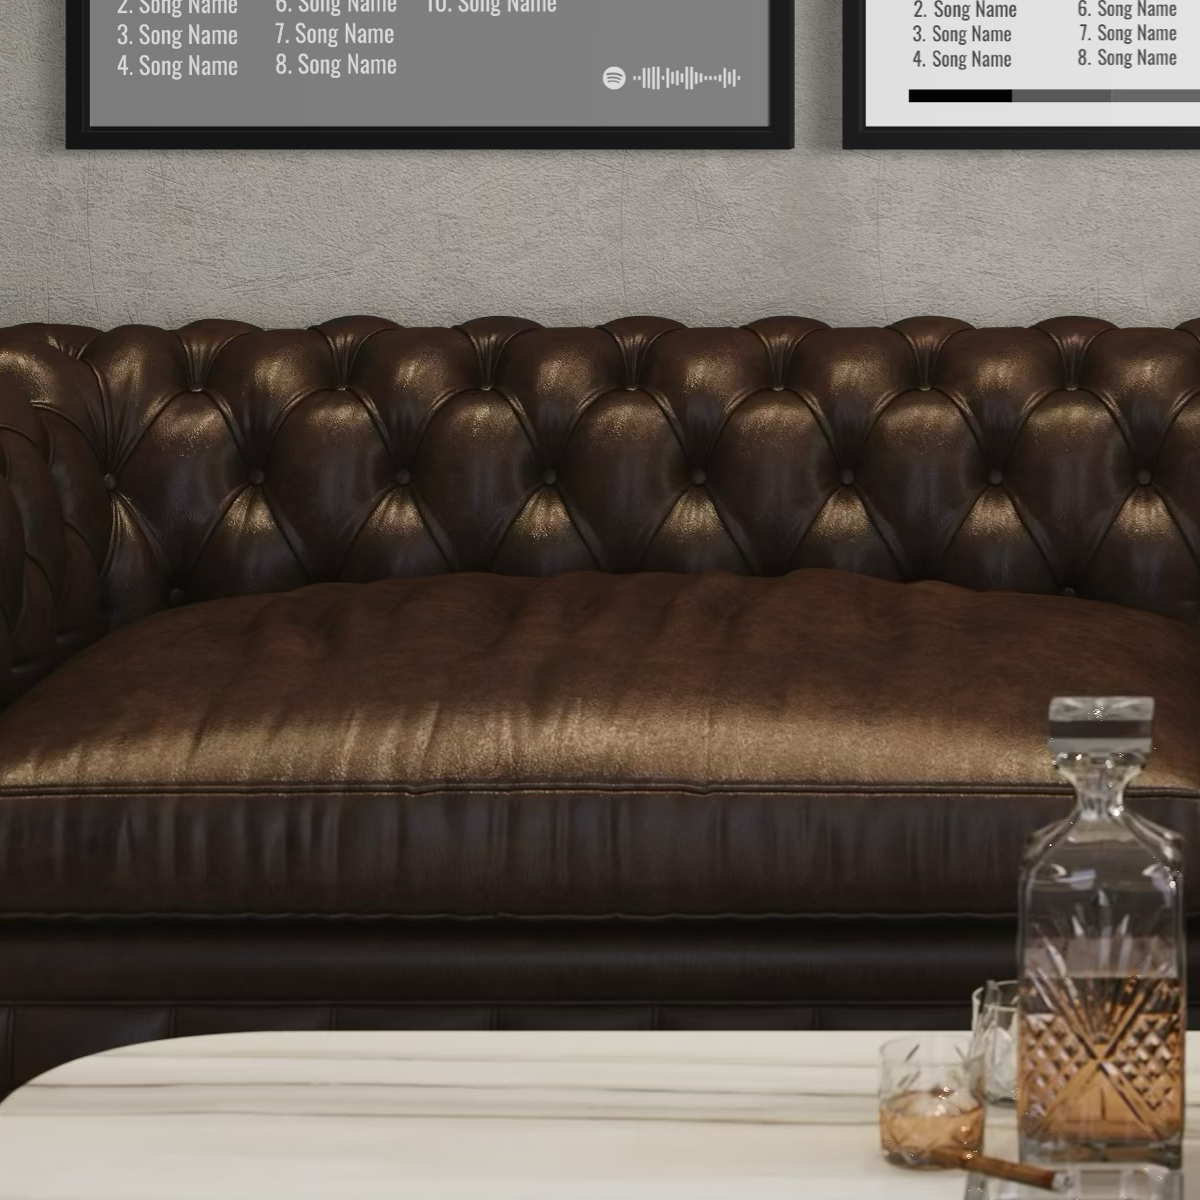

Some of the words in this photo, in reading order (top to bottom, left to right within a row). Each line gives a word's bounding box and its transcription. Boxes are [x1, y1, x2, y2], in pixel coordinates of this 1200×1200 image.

[913, 0, 927, 18] 2.
[934, 0, 971, 22] Song
[976, 0, 1017, 18] Name
[1078, 0, 1091, 17] 6.
[1097, 0, 1133, 20] Song
[1137, 0, 1177, 17] Name
[117, 23, 133, 45] 3.
[138, 23, 183, 50] Song
[188, 23, 238, 45] Name
[274, 22, 290, 44] 7.
[295, 22, 339, 48] Song
[345, 22, 395, 44] Name
[912, 24, 926, 42] 3.
[932, 24, 967, 46] Song
[972, 24, 1012, 42] Name
[1079, 23, 1092, 41] 7.
[1097, 23, 1133, 45] Song
[1137, 23, 1177, 41] Name
[117, 54, 133, 76] 4.
[139, 54, 183, 81] Song
[188, 54, 238, 76] Name
[275, 52, 292, 75] 8.
[298, 52, 342, 79] Song
[347, 53, 397, 75] Name
[912, 50, 926, 68] 4.
[932, 50, 968, 71] Song
[972, 50, 1012, 68] Name
[1077, 48, 1092, 66] 8.
[1097, 48, 1133, 69] Song
[1137, 48, 1177, 66] Name
